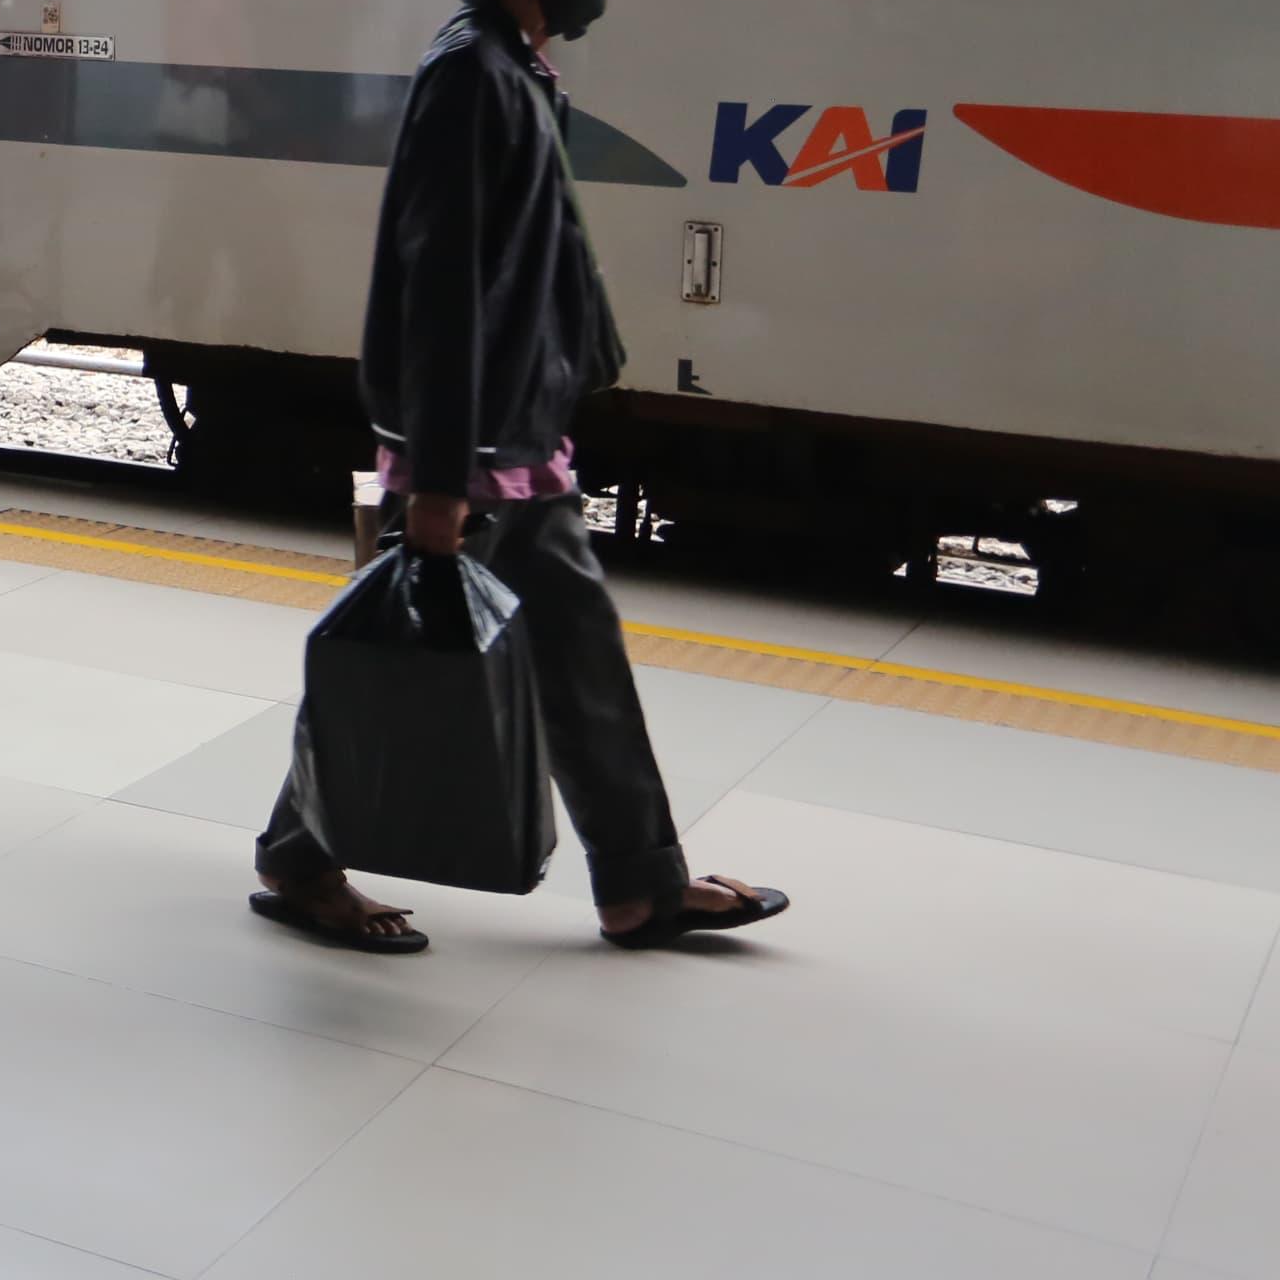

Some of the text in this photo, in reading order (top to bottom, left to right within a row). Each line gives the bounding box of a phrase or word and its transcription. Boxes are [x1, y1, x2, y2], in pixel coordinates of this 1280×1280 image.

[22, 36, 109, 56] NOMOR 13-24
[708, 101, 928, 194] KAI
